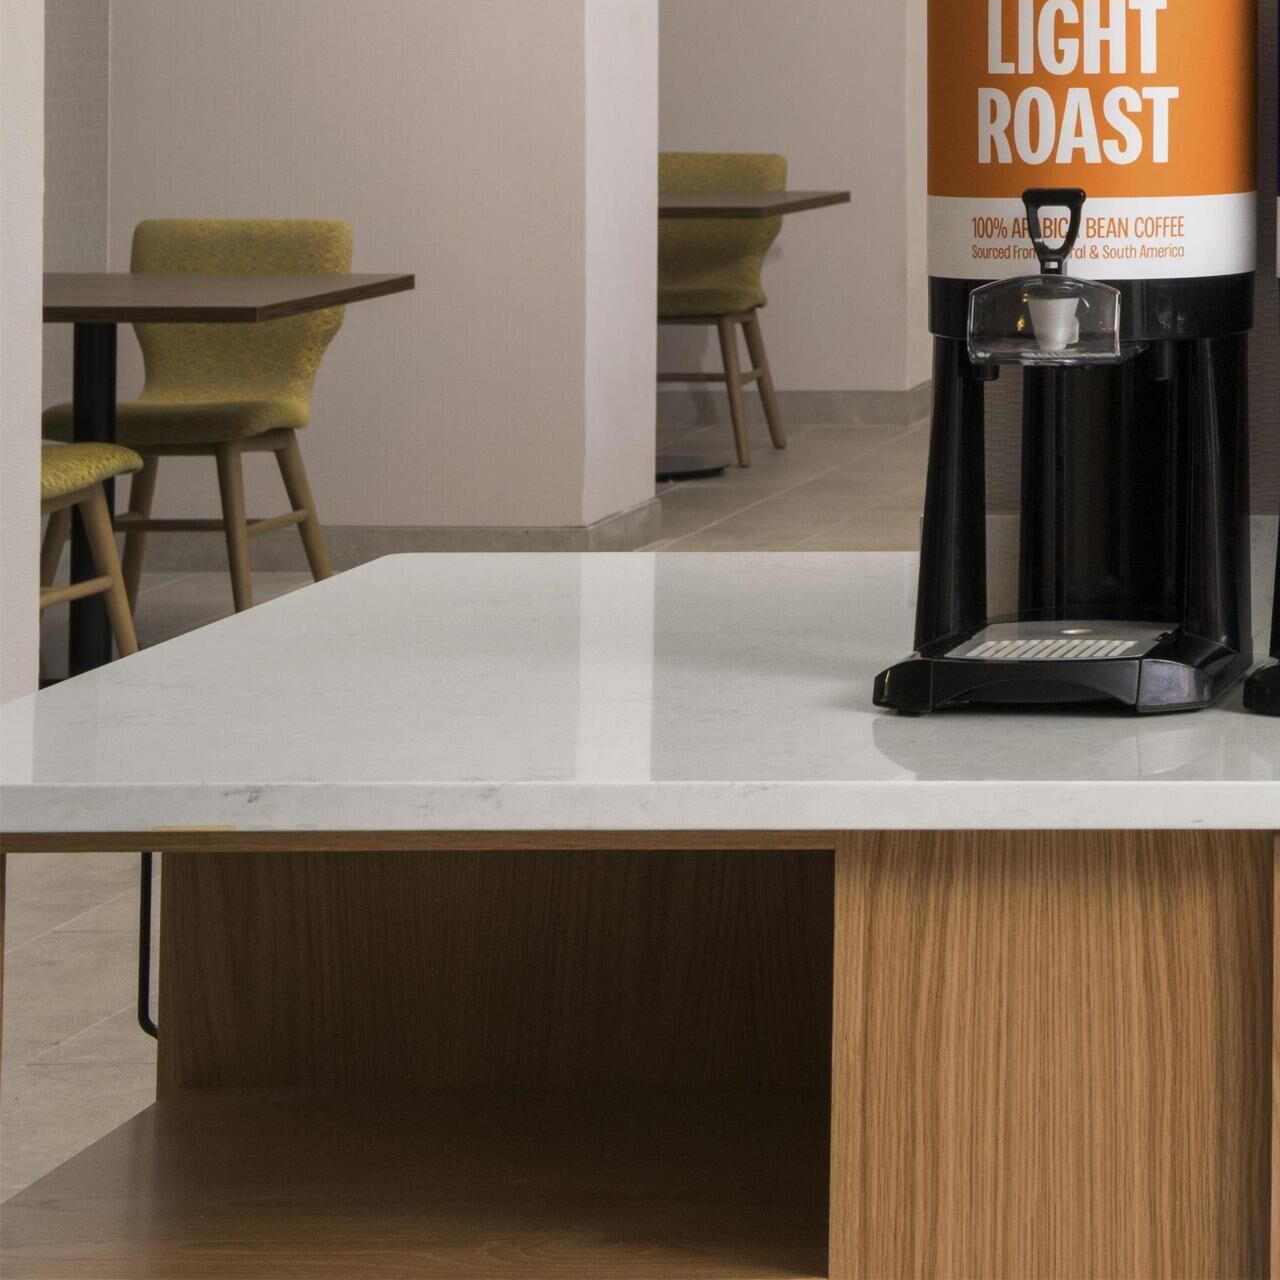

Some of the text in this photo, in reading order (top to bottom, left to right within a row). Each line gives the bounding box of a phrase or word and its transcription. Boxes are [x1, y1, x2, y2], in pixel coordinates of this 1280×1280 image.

[979, 85, 1180, 165] ROAST
[971, 216, 1007, 239] 100%
[1085, 216, 1128, 239] BEAN
[1133, 215, 1185, 238] COFFEE
[971, 243, 1011, 259] Sourced
[1089, 245, 1099, 259] &
[1102, 244, 1137, 259] South
[1139, 242, 1185, 258] America
